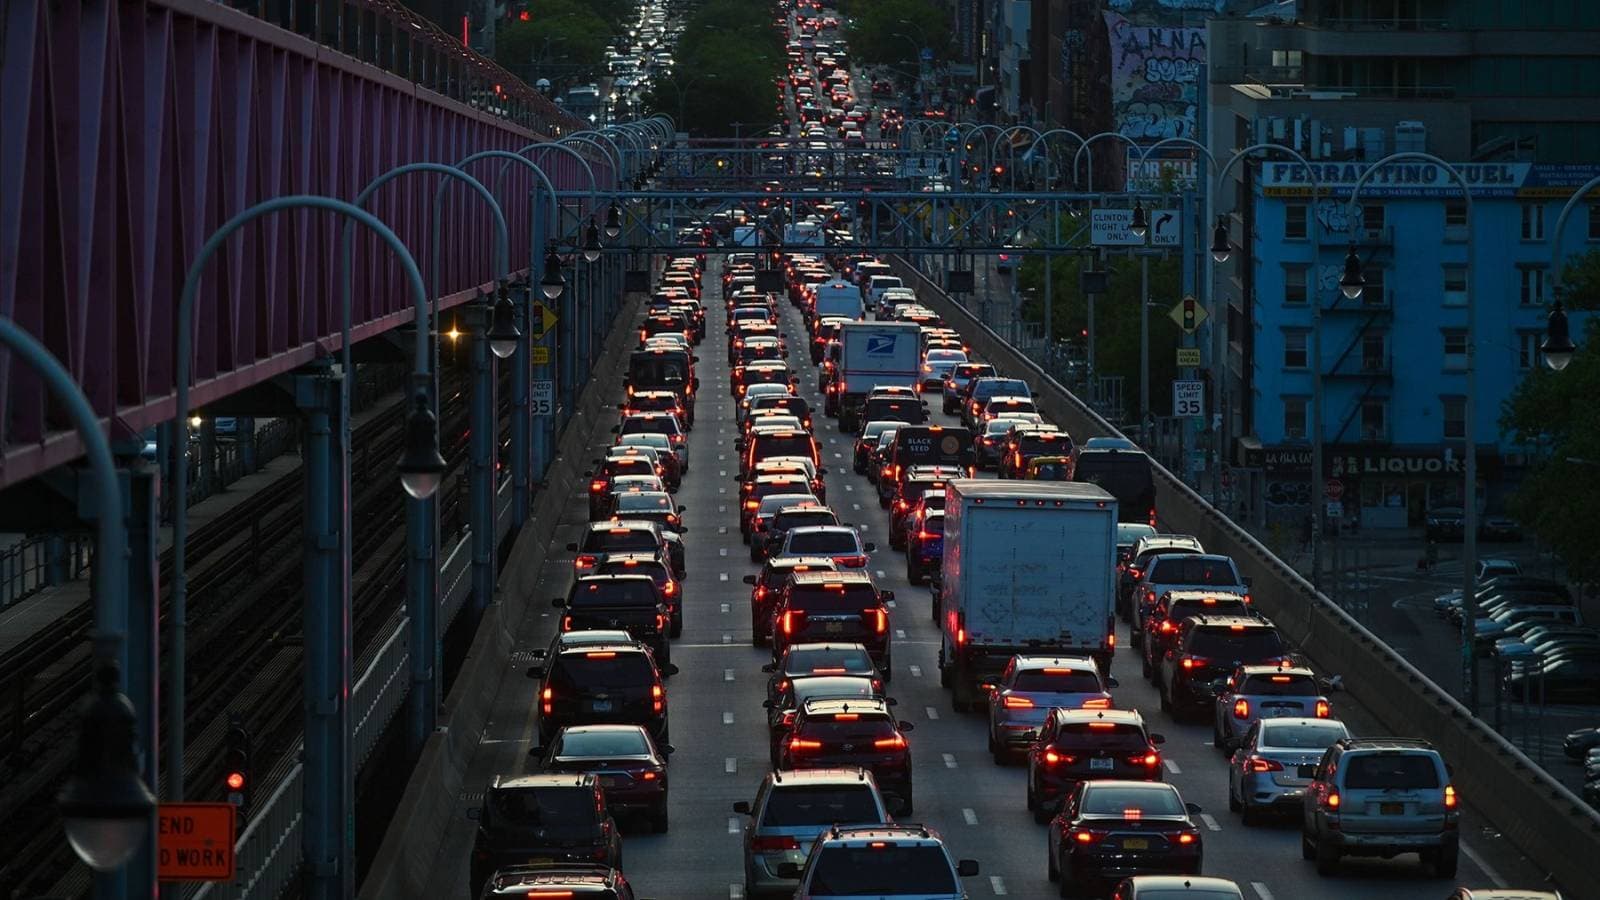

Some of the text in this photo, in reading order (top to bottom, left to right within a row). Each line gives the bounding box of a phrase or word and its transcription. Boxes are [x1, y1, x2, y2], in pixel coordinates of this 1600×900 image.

[1093, 214, 1128, 222] CLINTON
[1093, 223, 1117, 231] RIGHT
[1107, 233, 1129, 241] ONLY
[1155, 235, 1177, 244] ONLY
[1178, 401, 1200, 414] 35
[159, 816, 195, 835] END
[177, 848, 226, 867] WORK
